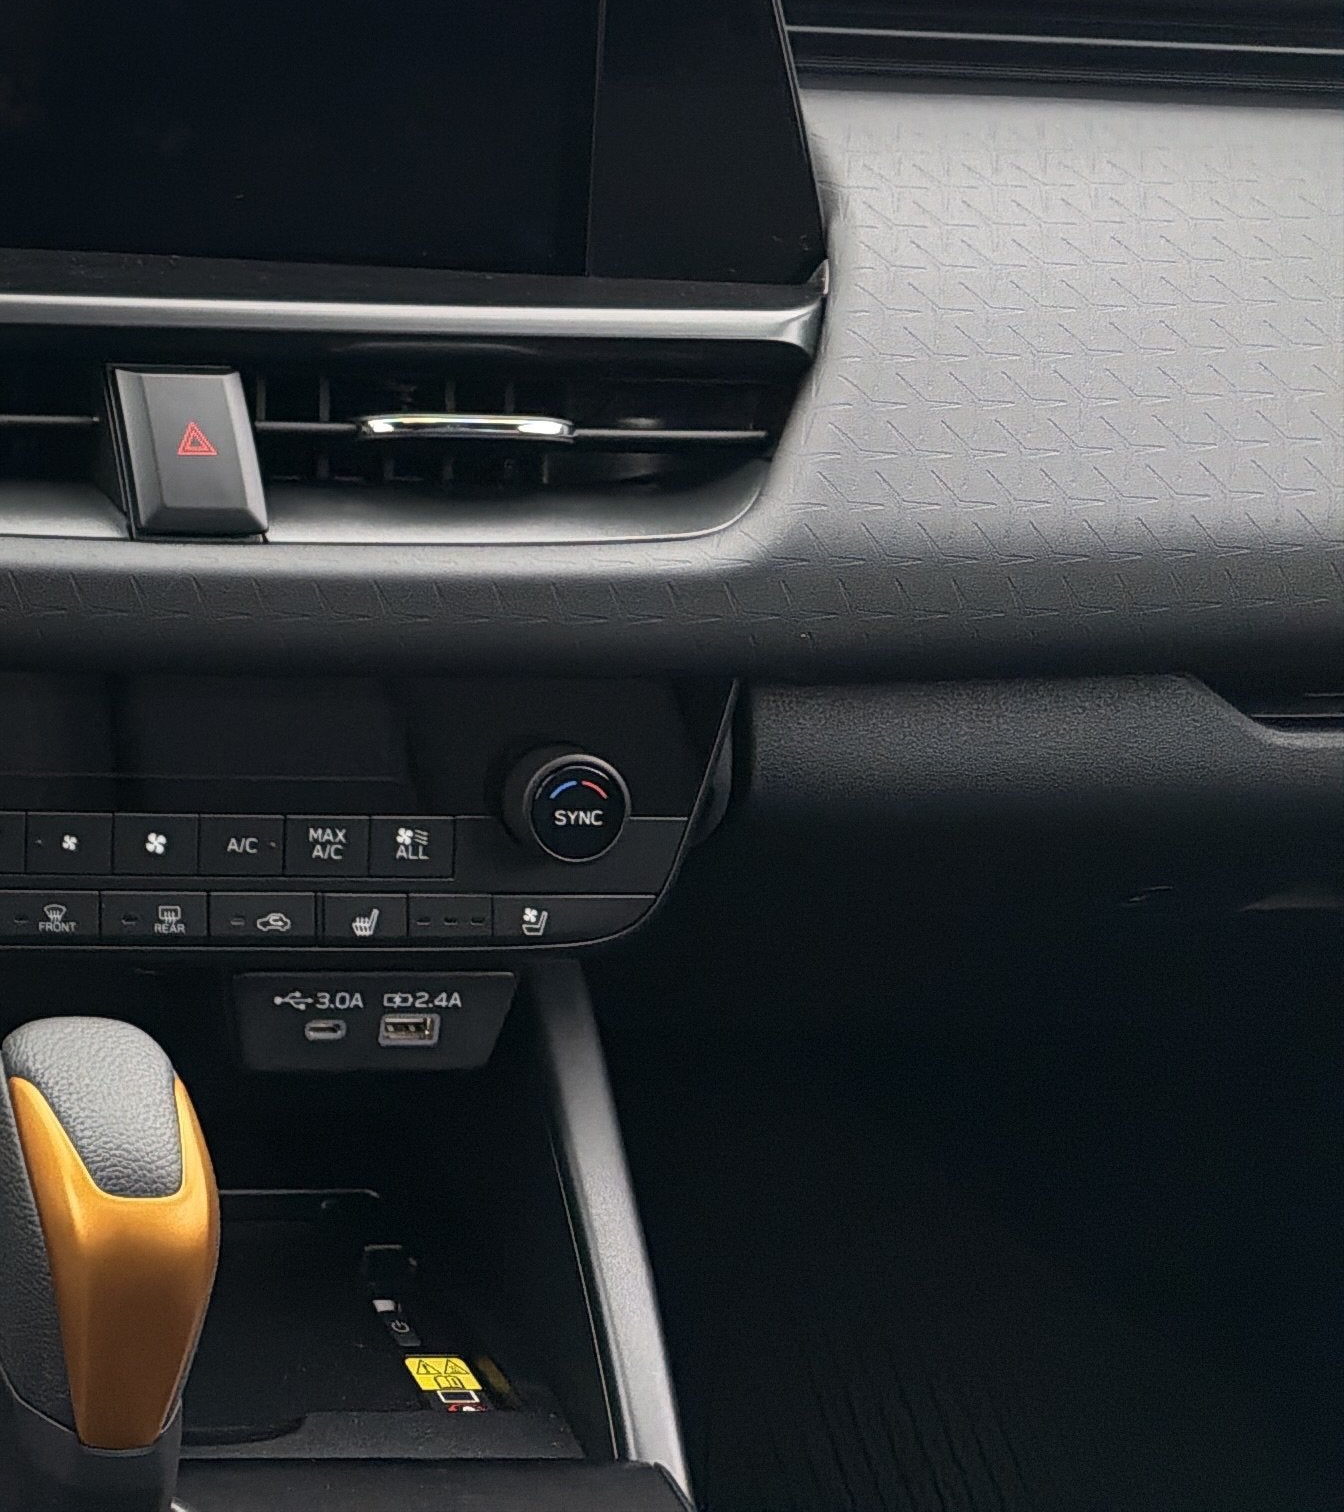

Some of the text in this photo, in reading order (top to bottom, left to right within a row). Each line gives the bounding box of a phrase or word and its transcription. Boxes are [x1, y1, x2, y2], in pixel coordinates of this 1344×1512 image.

[554, 808, 604, 827] SYNC
[308, 827, 348, 843] MAX
[226, 837, 259, 854] A/C
[311, 844, 344, 860] A/C
[395, 844, 430, 860] ALL
[38, 921, 78, 933] FRONT
[154, 923, 187, 934] REAR
[315, 992, 462, 1010] 3.0A 2.4A
